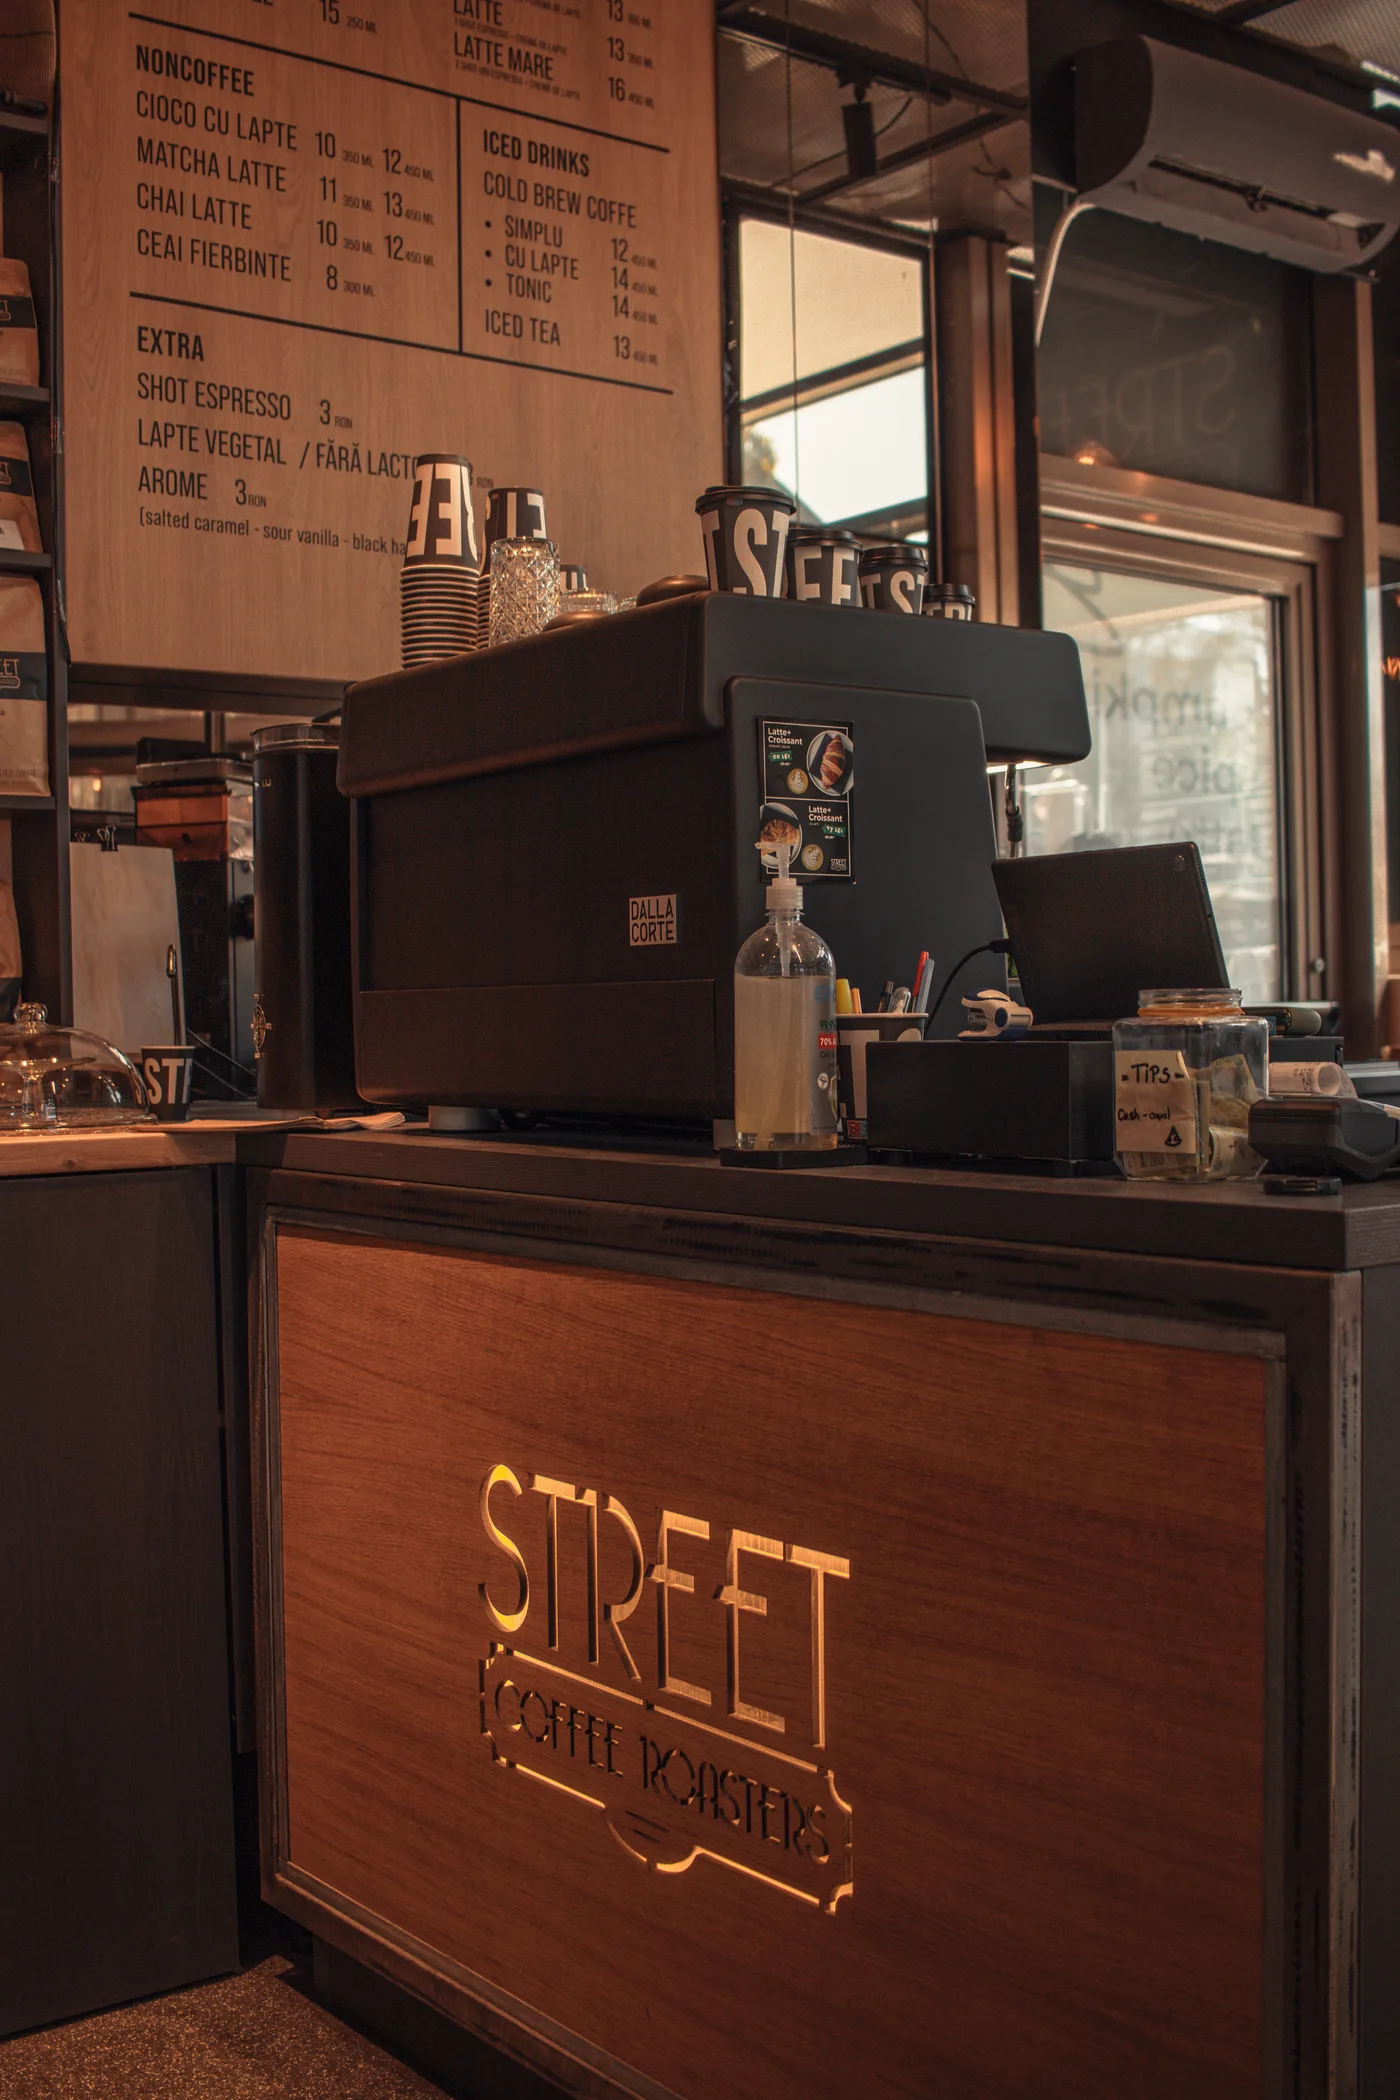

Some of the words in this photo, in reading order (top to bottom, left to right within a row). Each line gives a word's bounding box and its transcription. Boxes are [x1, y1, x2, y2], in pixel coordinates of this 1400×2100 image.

[320, 0, 340, 25] 15
[346, 15, 364, 31] 250
[365, 20, 378, 34] ML
[454, 0, 503, 26] LATTE
[606, 0, 624, 22] 13
[136, 44, 254, 97] NONCOFFEE
[454, 31, 504, 68] LATTE
[508, 46, 554, 81] MARE
[607, 36, 624, 61] 13
[608, 76, 625, 101] 16
[136, 90, 197, 128] CIOCO
[204, 105, 229, 135] CU
[237, 112, 298, 151] LAPTE
[315, 131, 336, 159] 10
[342, 149, 360, 164] 350
[361, 153, 374, 168] ML
[382, 148, 401, 175] 12
[404, 164, 421, 178] 450
[422, 168, 435, 181] ML
[483, 128, 522, 161] ICED
[527, 140, 590, 178] DRINKS
[137, 136, 220, 179] MATCHA
[227, 155, 286, 192] LATTE
[319, 176, 337, 202] 11
[343, 195, 360, 209] 350
[361, 199, 374, 212] ML
[383, 191, 403, 218] 13
[404, 209, 421, 222] 450
[423, 213, 435, 226] ML
[483, 170, 528, 203] COLD
[534, 182, 581, 215] BREW
[587, 195, 637, 229] COFFE
[137, 182, 184, 217] CHAI
[192, 193, 252, 230] LATTE
[316, 219, 337, 247] 10
[343, 237, 360, 251] 350
[362, 241, 375, 255] ML
[384, 234, 403, 261] 12
[404, 251, 422, 264] 450
[423, 255, 436, 267] ML
[504, 214, 563, 248] SIMPLU
[611, 237, 628, 263] 12
[137, 229, 182, 262] CEAI
[190, 238, 291, 282] FIERBINTE
[326, 264, 338, 291] 8
[343, 280, 360, 295] 300
[362, 284, 376, 297] ML
[505, 243, 525, 269] CU
[531, 249, 579, 281] LAPTE
[611, 266, 629, 290] 14
[505, 272, 552, 303] TONIC
[612, 295, 630, 319] 14
[137, 325, 204, 361] EXTRA
[485, 308, 523, 339] ICED
[529, 317, 561, 346] TEA
[613, 334, 630, 360] 13
[137, 372, 188, 405] SHOT
[195, 381, 291, 420] ESPRESSO
[319, 399, 331, 425] 3
[335, 415, 353, 429] RON
[138, 418, 200, 453] LAPTE
[205, 428, 287, 465] VEGETAL
[316, 438, 362, 473] FĂRĂ
[138, 466, 208, 500] AROME
[235, 478, 247, 505] 3
[248, 494, 267, 508] RON
[139, 506, 189, 530] (salted
[194, 515, 249, 536] caramel
[263, 525, 293, 541] sour
[296, 528, 339, 548] vanilla
[352, 533, 387, 554] black
[768, 727, 791, 736] Latte+
[768, 736, 803, 745] Croissant
[808, 805, 831, 814] Latte+
[808, 813, 843, 823] Croissant
[631, 897, 674, 921] DALLA
[631, 921, 675, 942] CORTE
[820, 1037, 832, 1046] 70%
[477, 1463, 850, 1750] STREET
[494, 1679, 624, 1778] COFFEE
[639, 1734, 830, 1864] ROASTERS
